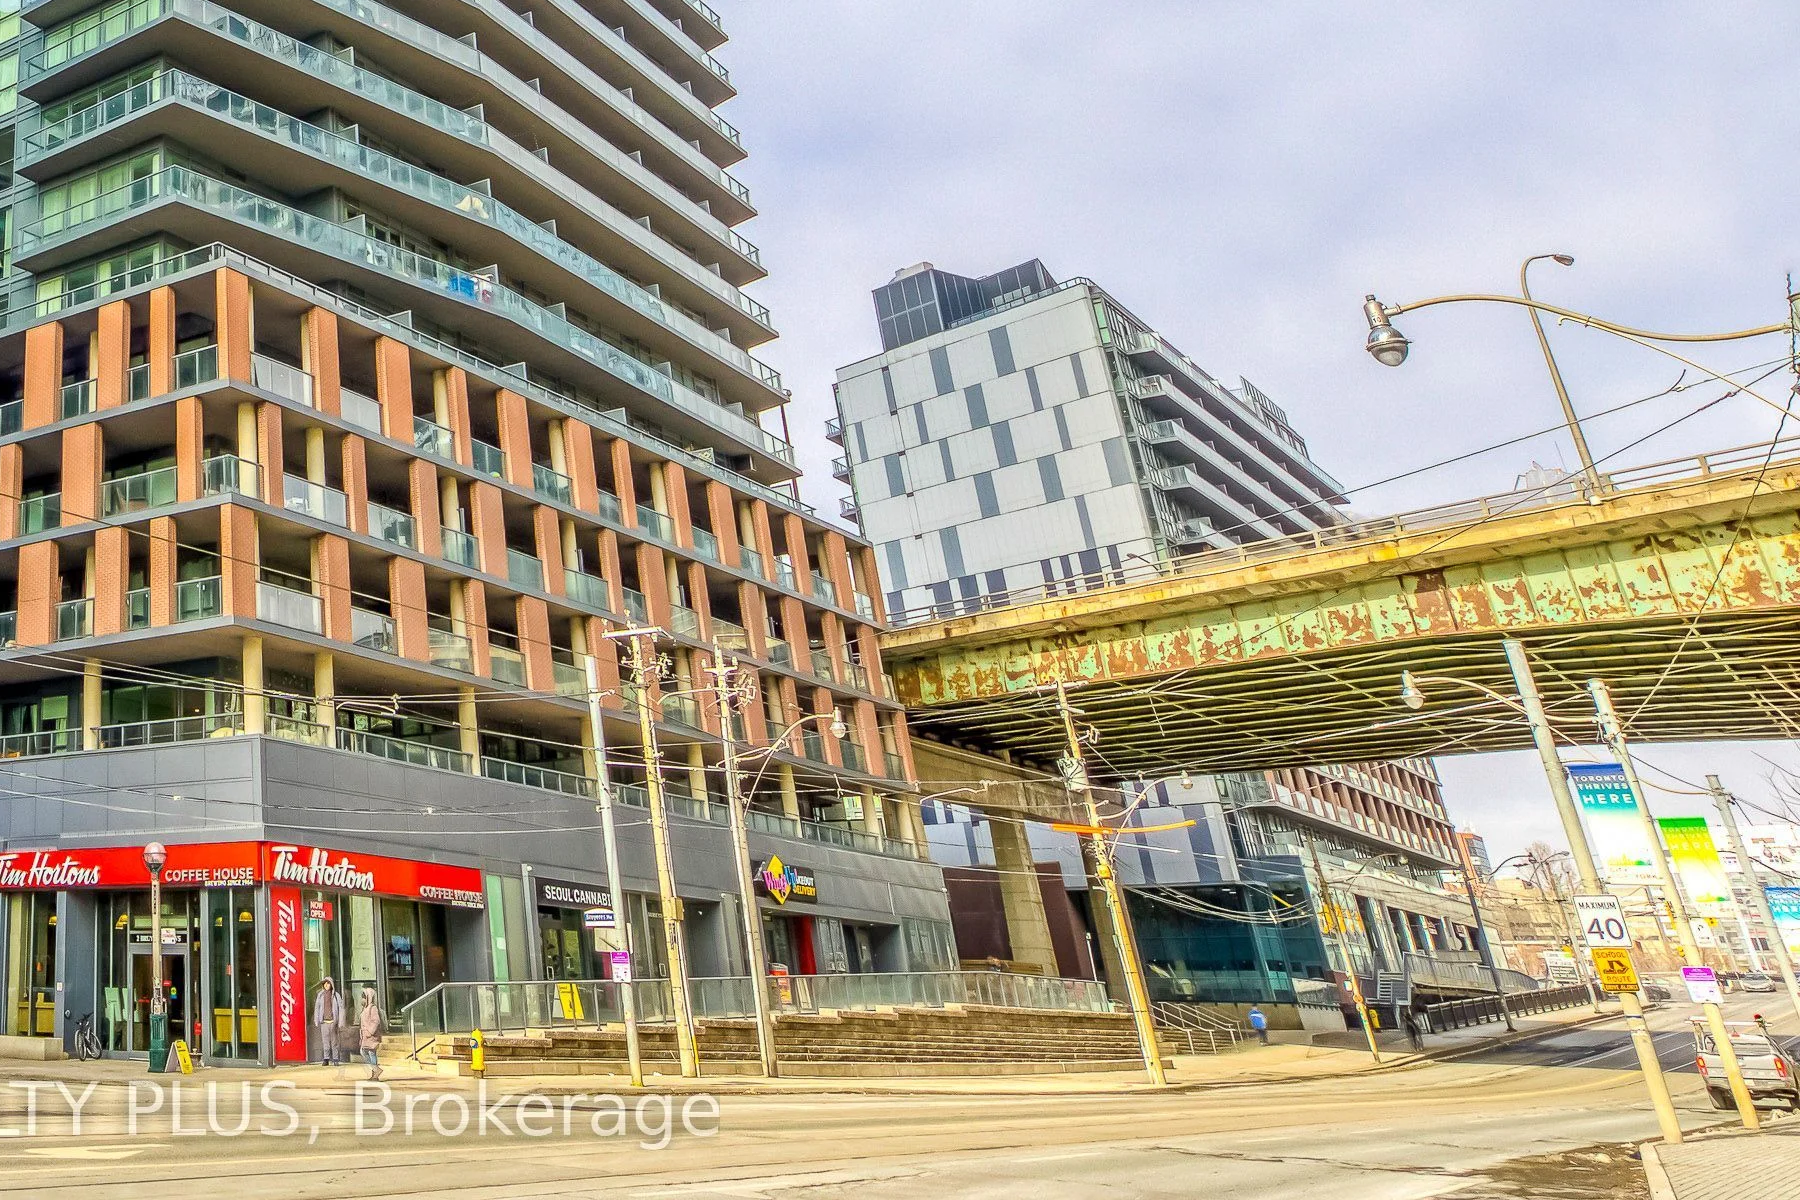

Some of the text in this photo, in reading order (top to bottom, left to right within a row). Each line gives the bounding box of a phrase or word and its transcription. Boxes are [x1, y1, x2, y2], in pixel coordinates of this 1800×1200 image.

[1573, 774, 1626, 782] TORONTO
[1583, 793, 1633, 804] HERE
[28, 852, 100, 886] Hortons
[165, 867, 254, 881] COFFEE HOUSE
[271, 846, 374, 891] Tim Hortons
[420, 885, 483, 903] COFFEE HOUSE
[545, 885, 612, 906] SEOUL CANNABI
[310, 901, 324, 910] NOW
[310, 909, 326, 919] OPEN
[1587, 918, 1624, 940] 40
[278, 900, 296, 1042] Tim Hortons
